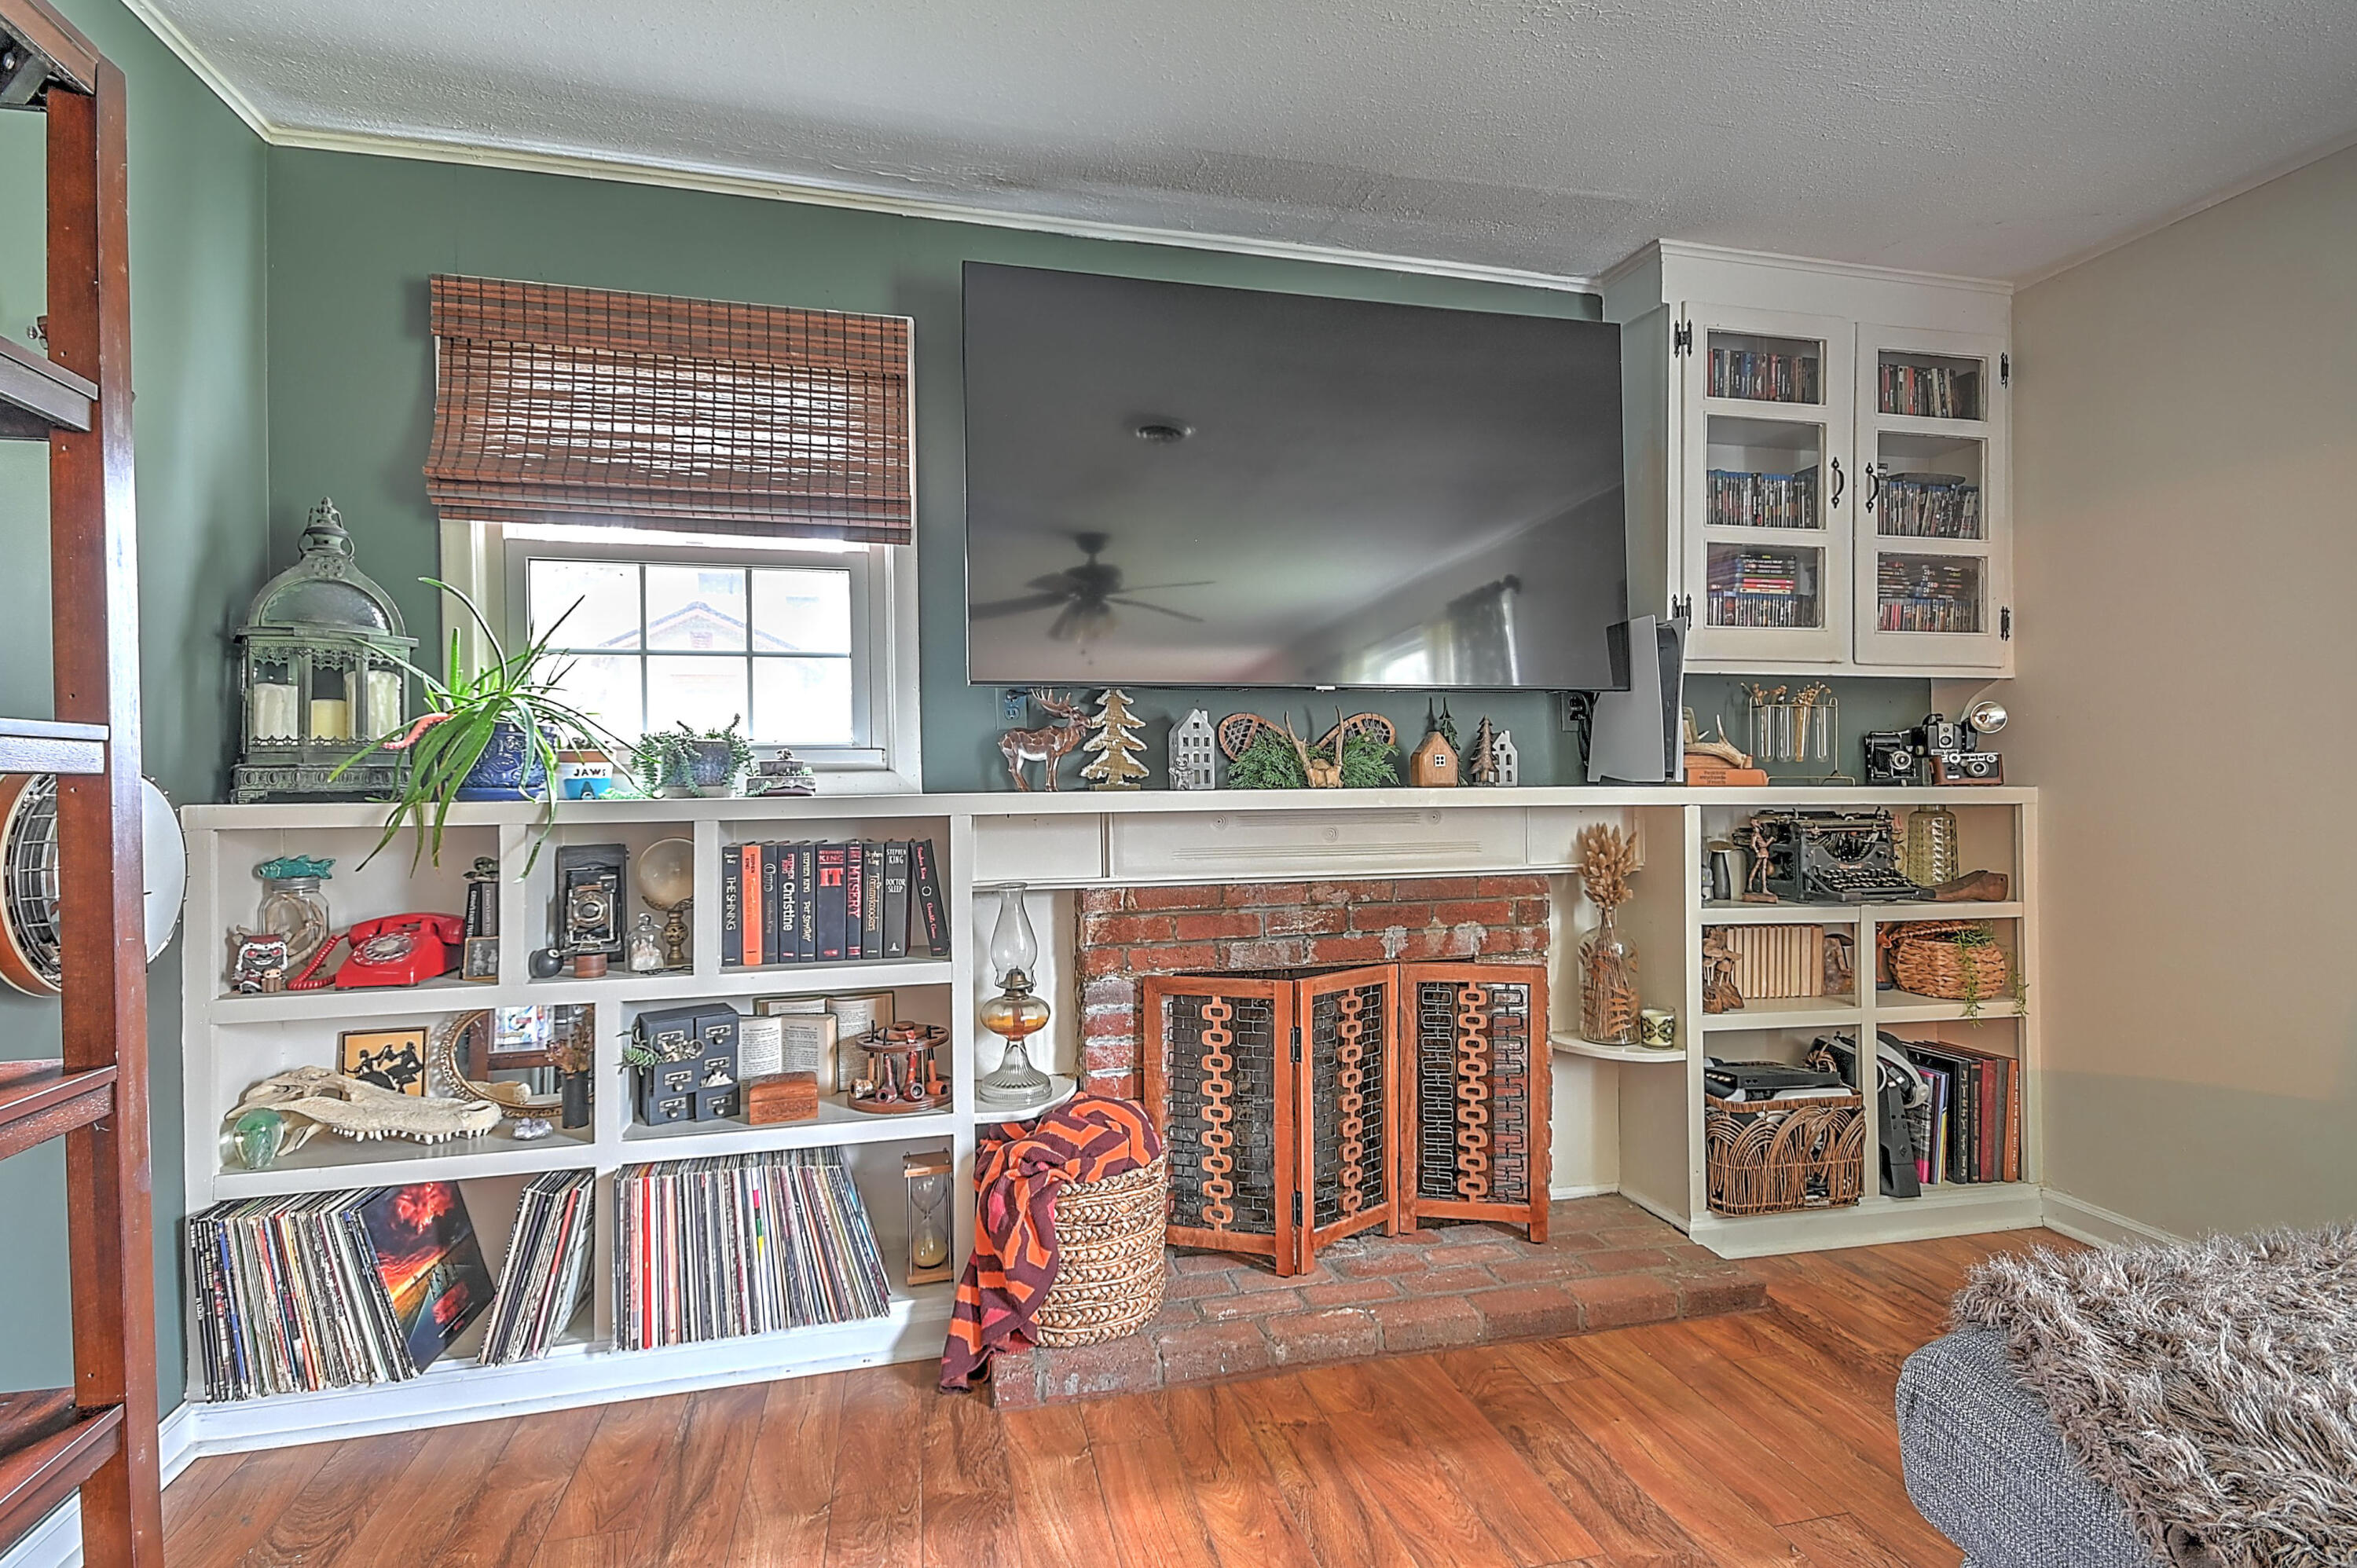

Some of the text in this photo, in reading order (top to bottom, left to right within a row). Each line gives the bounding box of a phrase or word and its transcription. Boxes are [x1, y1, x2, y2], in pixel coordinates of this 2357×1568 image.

[574, 768, 606, 777] JAWS
[889, 855, 904, 864] KING
[819, 866, 844, 887] IT
[848, 865, 861, 918] MISERY
[783, 881, 796, 931] Christine
